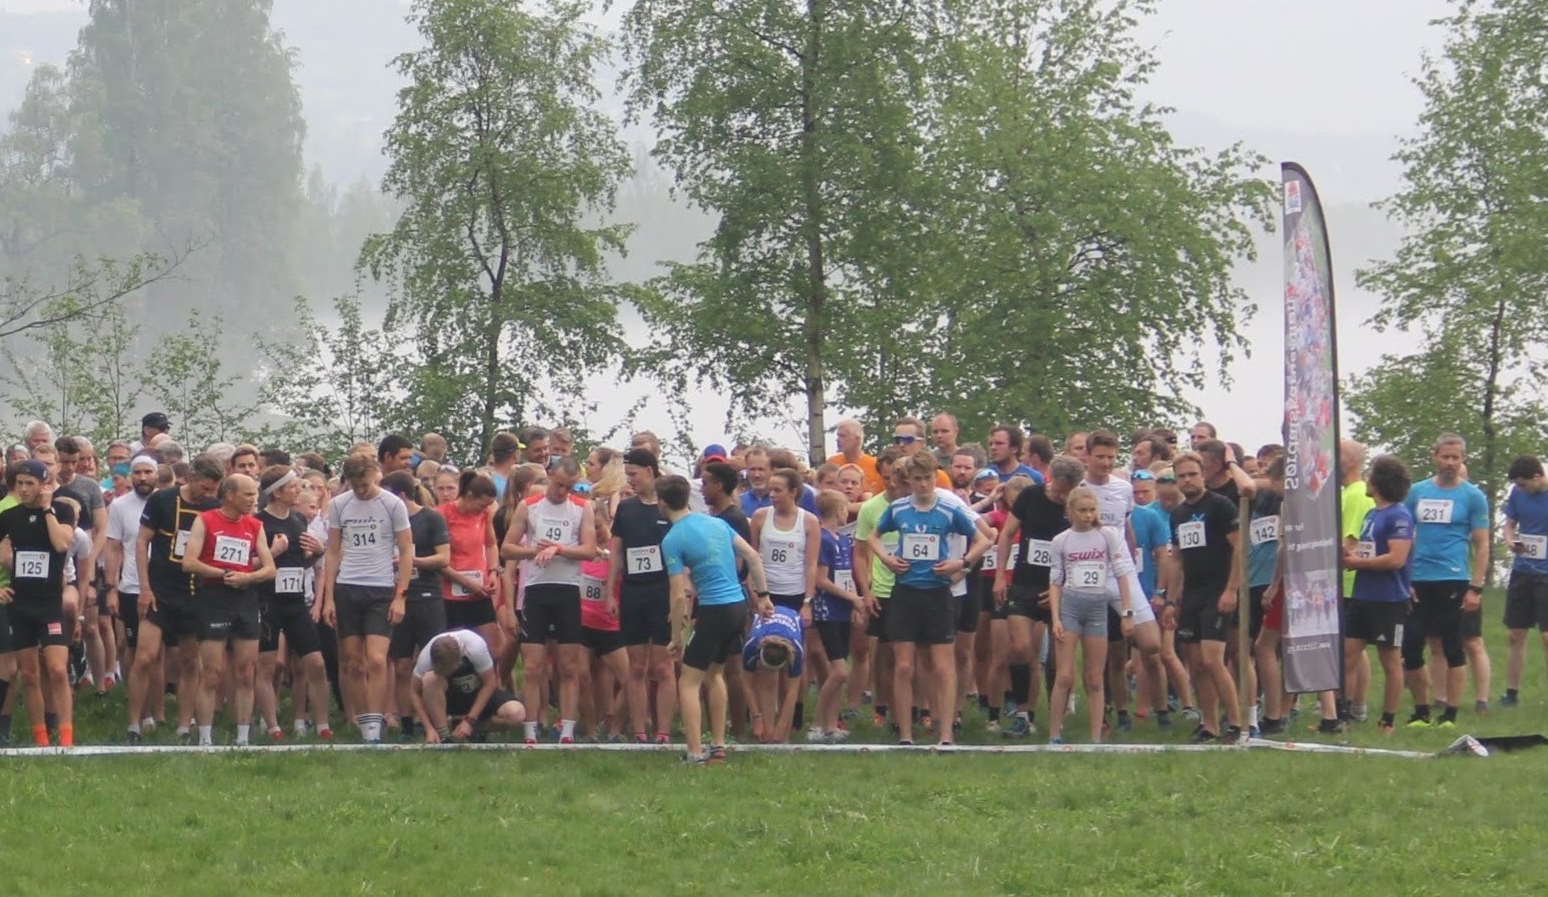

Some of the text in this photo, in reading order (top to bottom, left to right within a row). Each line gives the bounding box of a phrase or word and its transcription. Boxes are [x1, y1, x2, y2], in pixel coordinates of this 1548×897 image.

[1422, 507, 1445, 521] 231
[353, 532, 376, 546] 314
[546, 527, 561, 541] 49
[1182, 532, 1200, 545] 130
[1255, 526, 1275, 541] 142
[220, 546, 242, 562] 271
[771, 549, 786, 562] 86
[913, 544, 928, 557] 64
[1034, 549, 1052, 564] 28
[1068, 548, 1106, 562] swix
[21, 561, 42, 575] 125
[636, 557, 651, 571] 73
[1084, 571, 1099, 584] 29
[586, 586, 601, 599] 88
